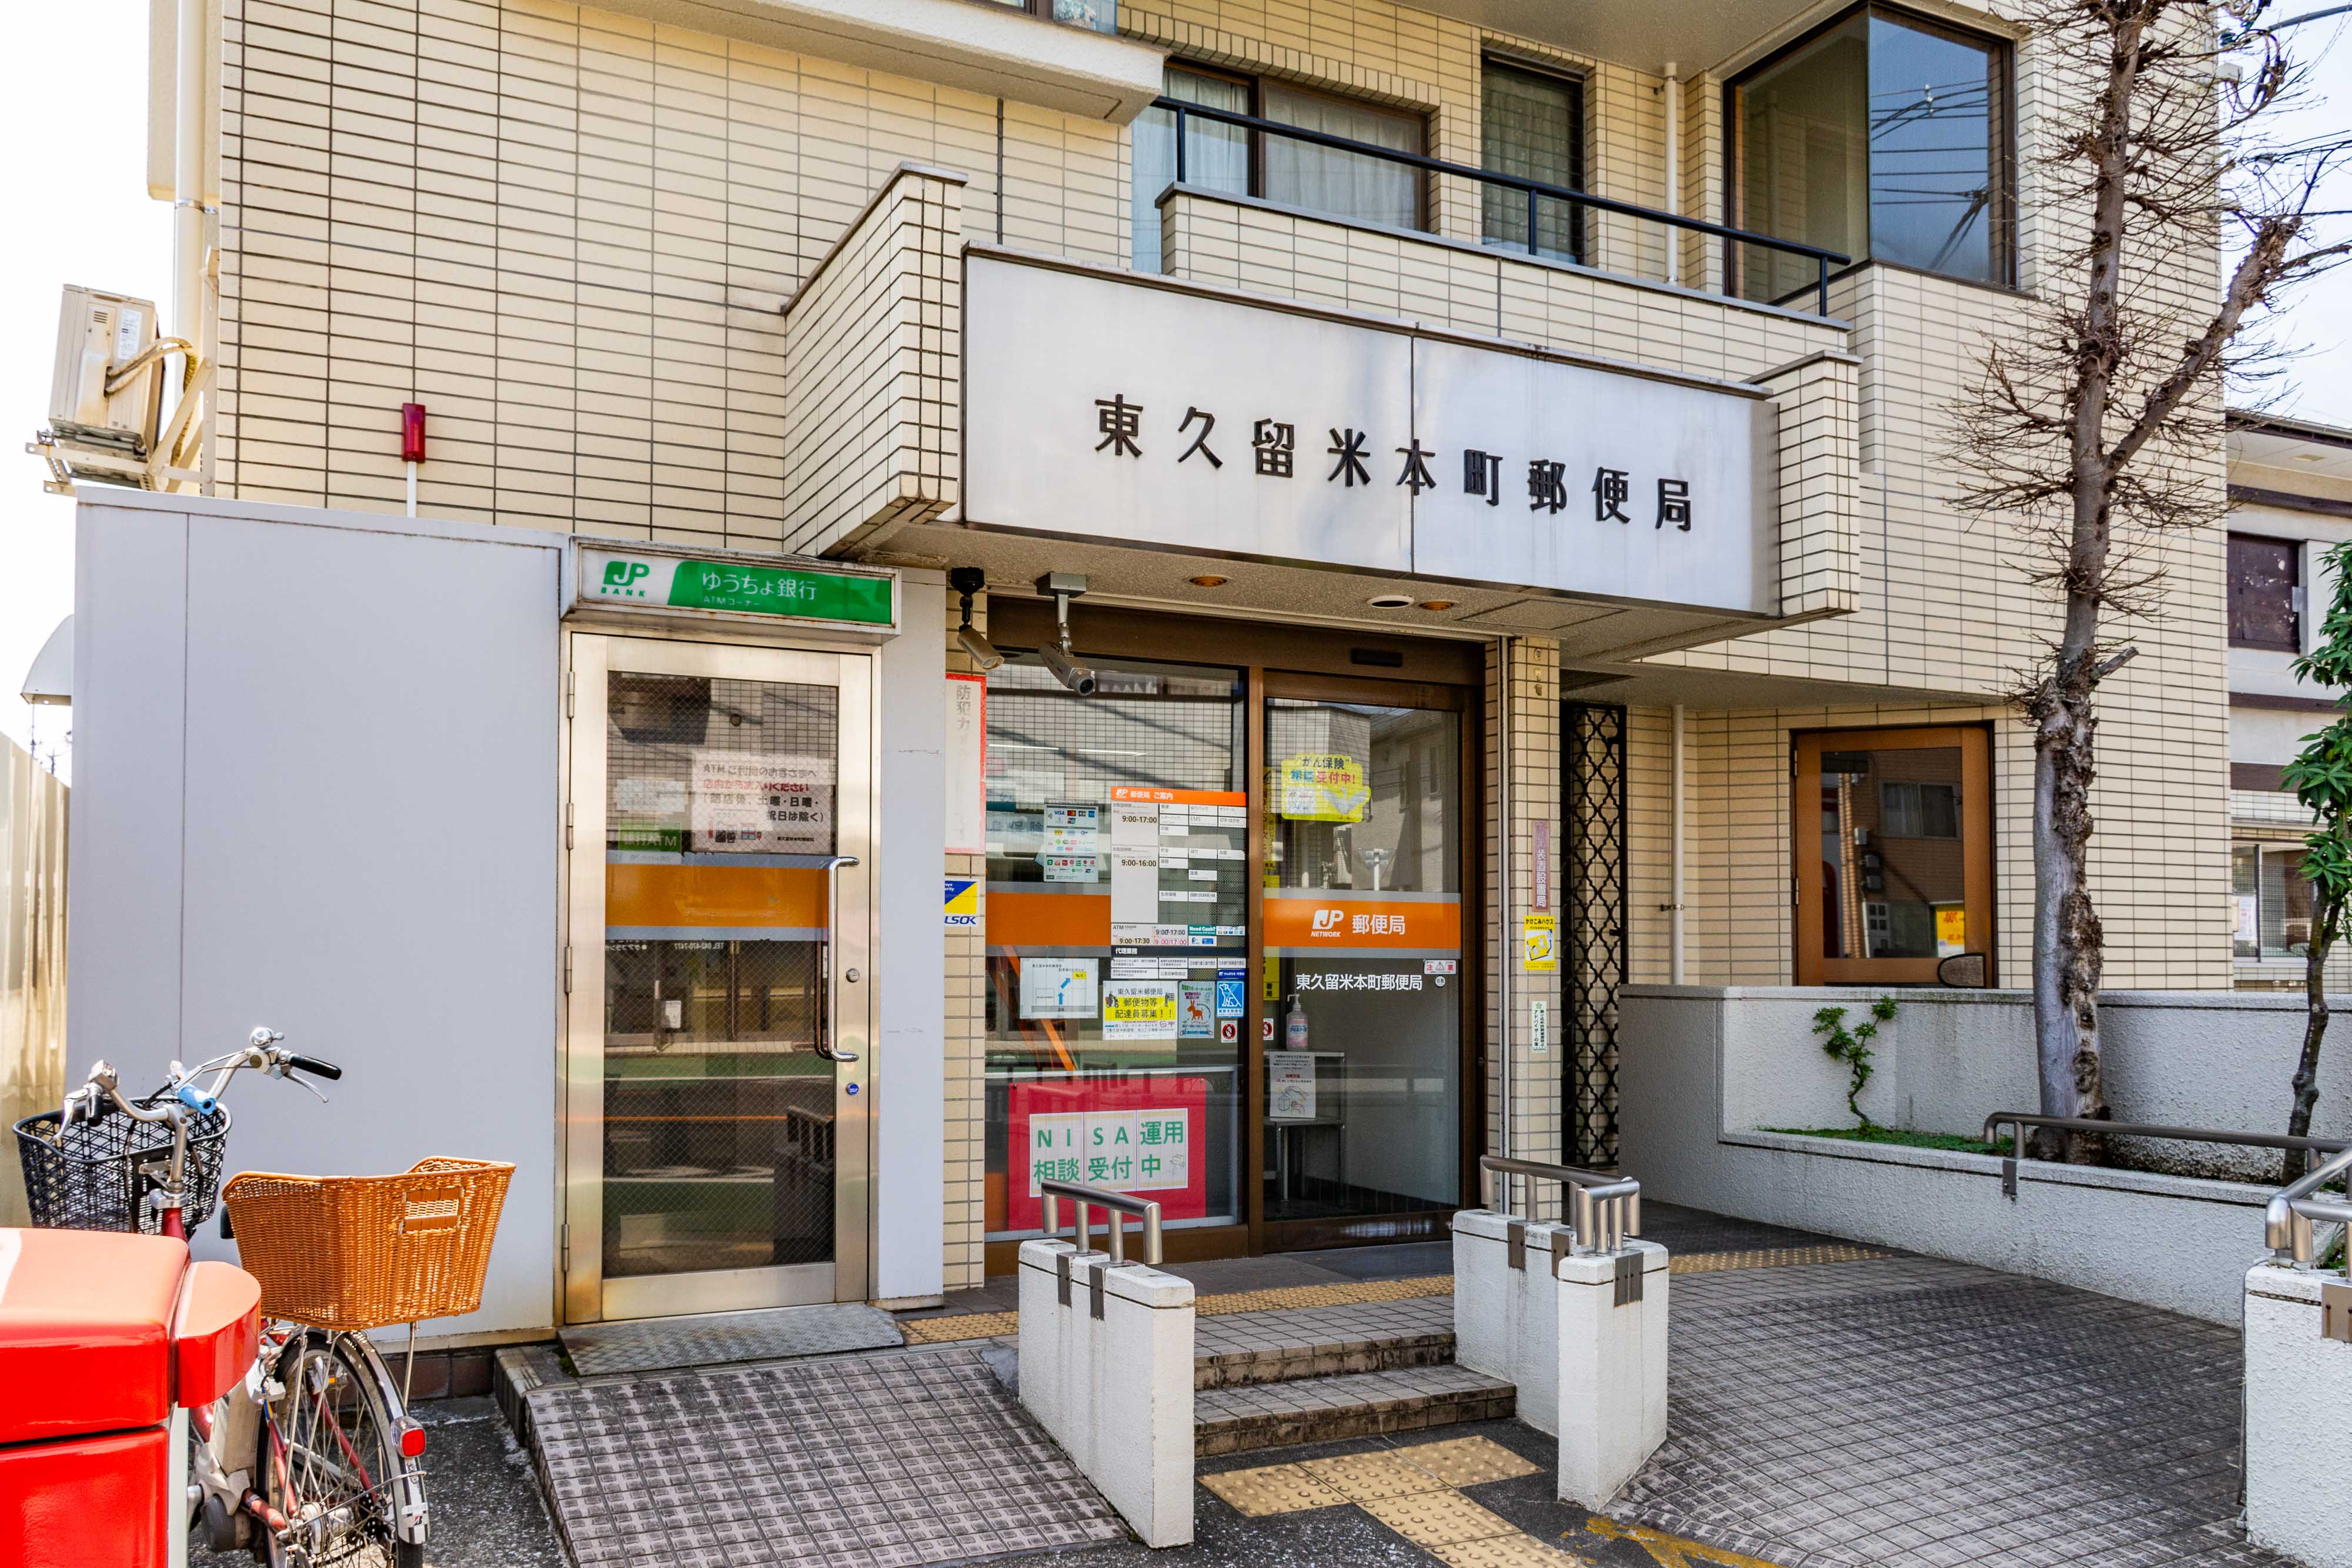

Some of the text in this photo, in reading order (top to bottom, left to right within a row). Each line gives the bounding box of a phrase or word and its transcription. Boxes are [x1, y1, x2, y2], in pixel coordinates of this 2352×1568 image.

[1095, 393, 1692, 532] 東久留米本町郵便局
[603, 561, 650, 586] JP
[702, 571, 818, 601] ゆうちょ銀行
[601, 586, 645, 597] BANK
[1130, 790, 1150, 798] 郵便局
[1153, 791, 1173, 800] ご案内
[1312, 910, 1406, 935] JP 郵便局
[1295, 974, 1423, 991] 東久留米本町郵便局
[1123, 997, 1158, 1007] 郵便物等
[1033, 1154, 1161, 1185] 相談受付中
